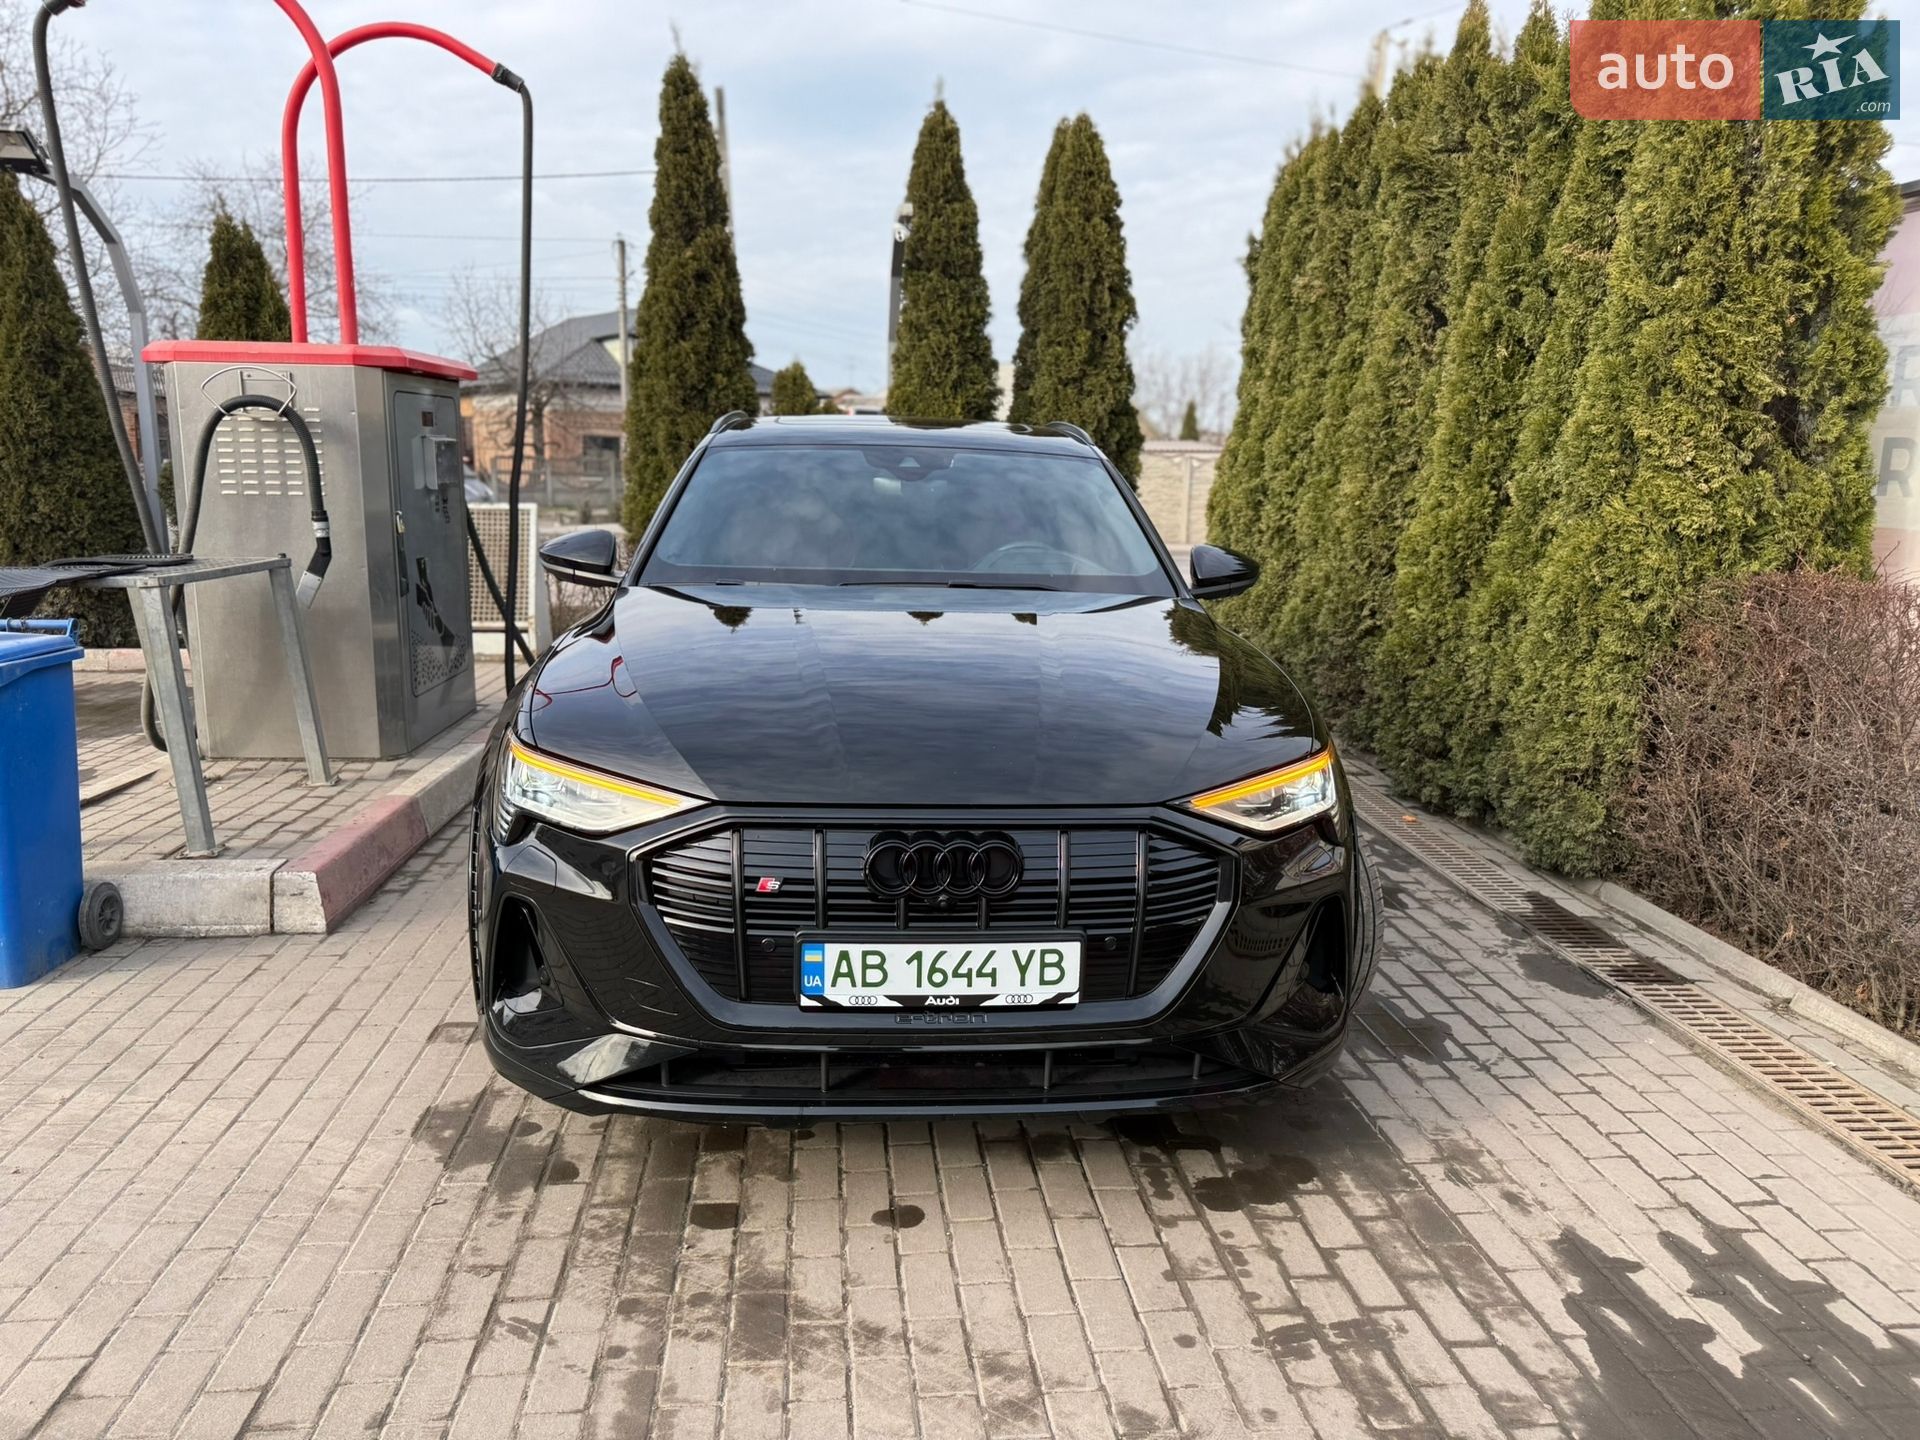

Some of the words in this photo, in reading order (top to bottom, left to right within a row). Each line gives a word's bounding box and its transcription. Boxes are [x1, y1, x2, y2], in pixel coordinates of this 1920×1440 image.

[830, 949, 888, 988] AB
[905, 949, 998, 988] 1644
[1011, 948, 1066, 987] YB
[804, 975, 822, 987] UA
[924, 995, 960, 1006] Audi
